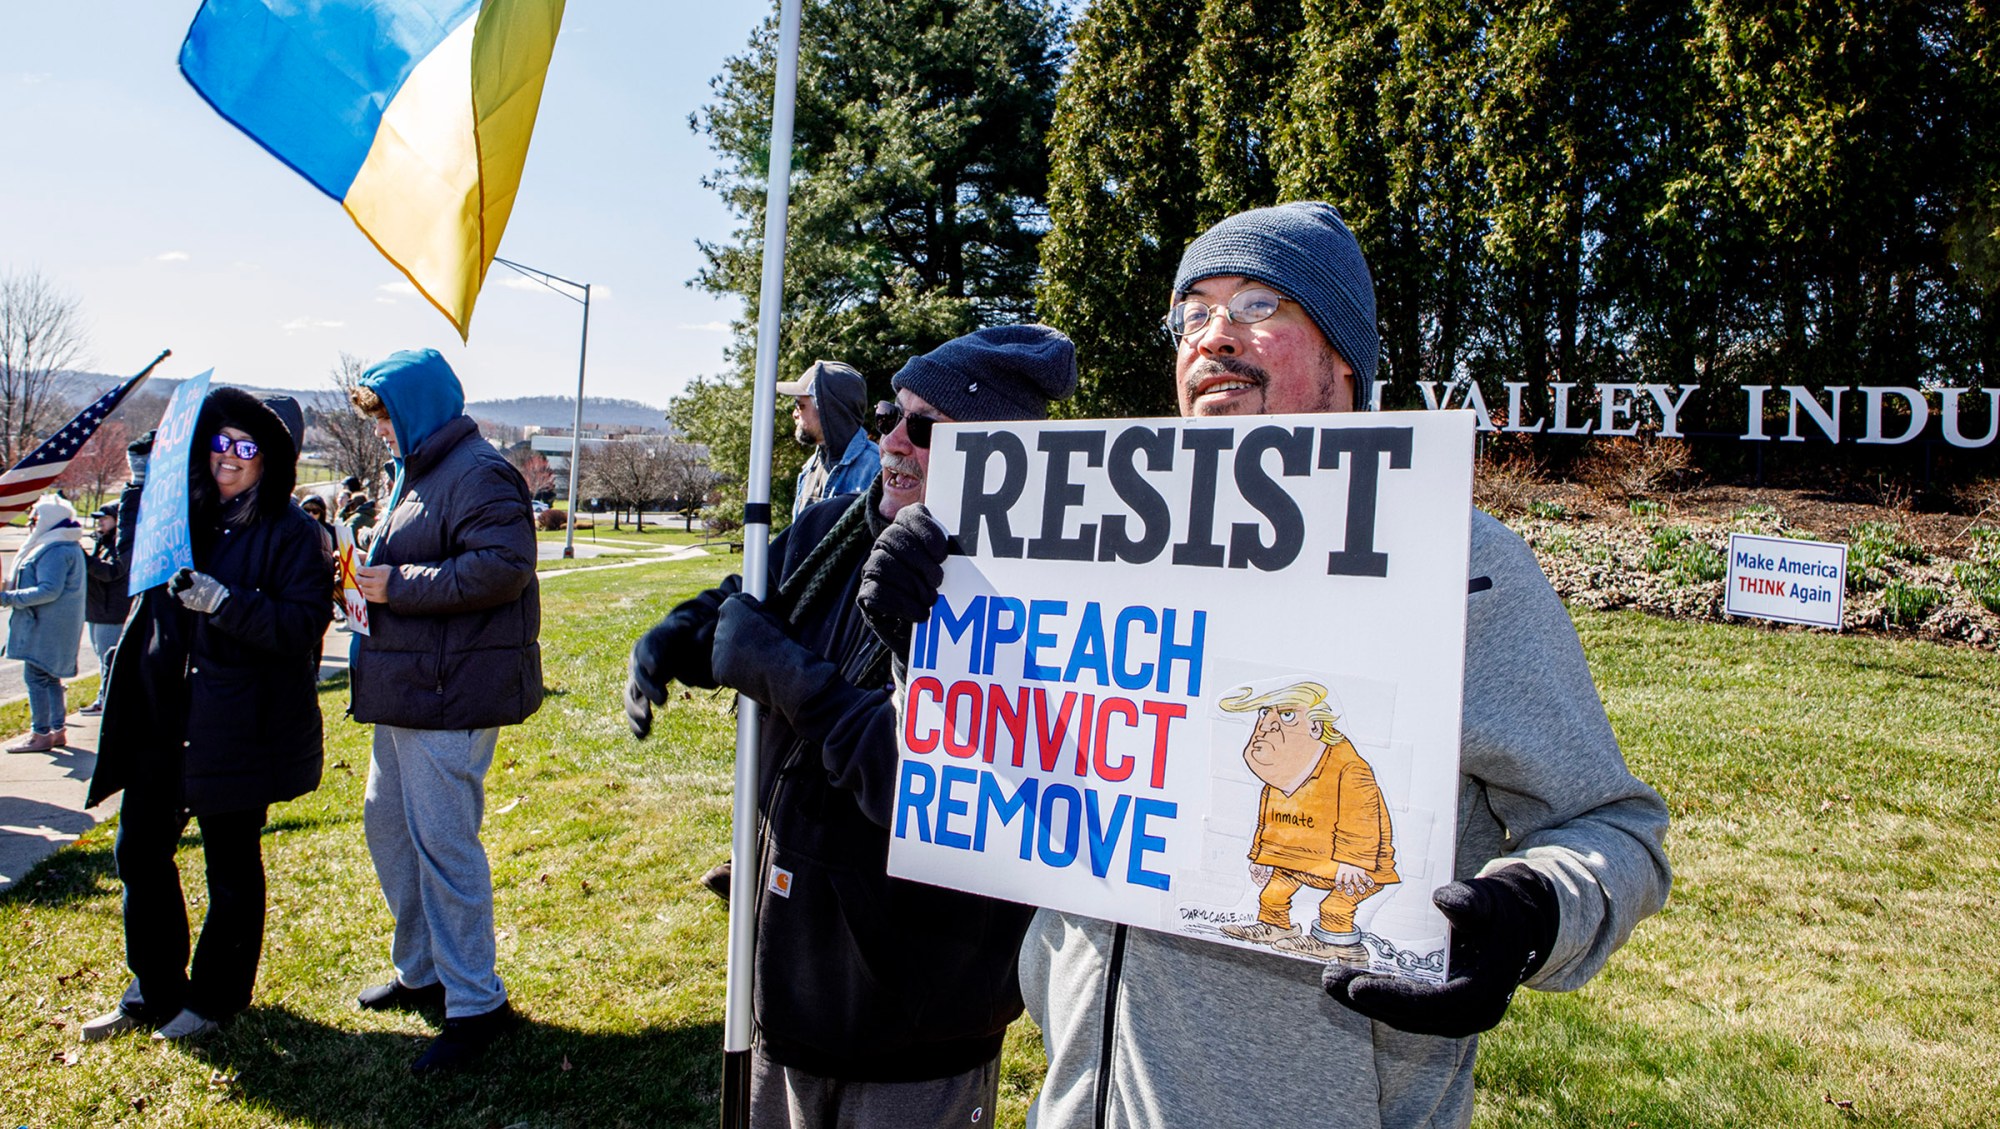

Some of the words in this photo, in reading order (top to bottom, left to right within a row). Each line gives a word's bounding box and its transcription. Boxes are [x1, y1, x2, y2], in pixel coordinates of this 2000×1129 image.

[1416, 380, 1700, 438] VALLEY
[1740, 385, 2000, 448] INDU
[948, 426, 1413, 578] RESIST
[1736, 552, 1774, 571] Make
[1778, 557, 1838, 579] America
[1738, 576, 1785, 597] THINK
[1789, 583, 1831, 603] Again
[912, 595, 1206, 697] IMPEACH
[905, 677, 1187, 789] CONVICT
[896, 760, 1178, 891] REMOVE
[1271, 808, 1315, 829] Inmate
